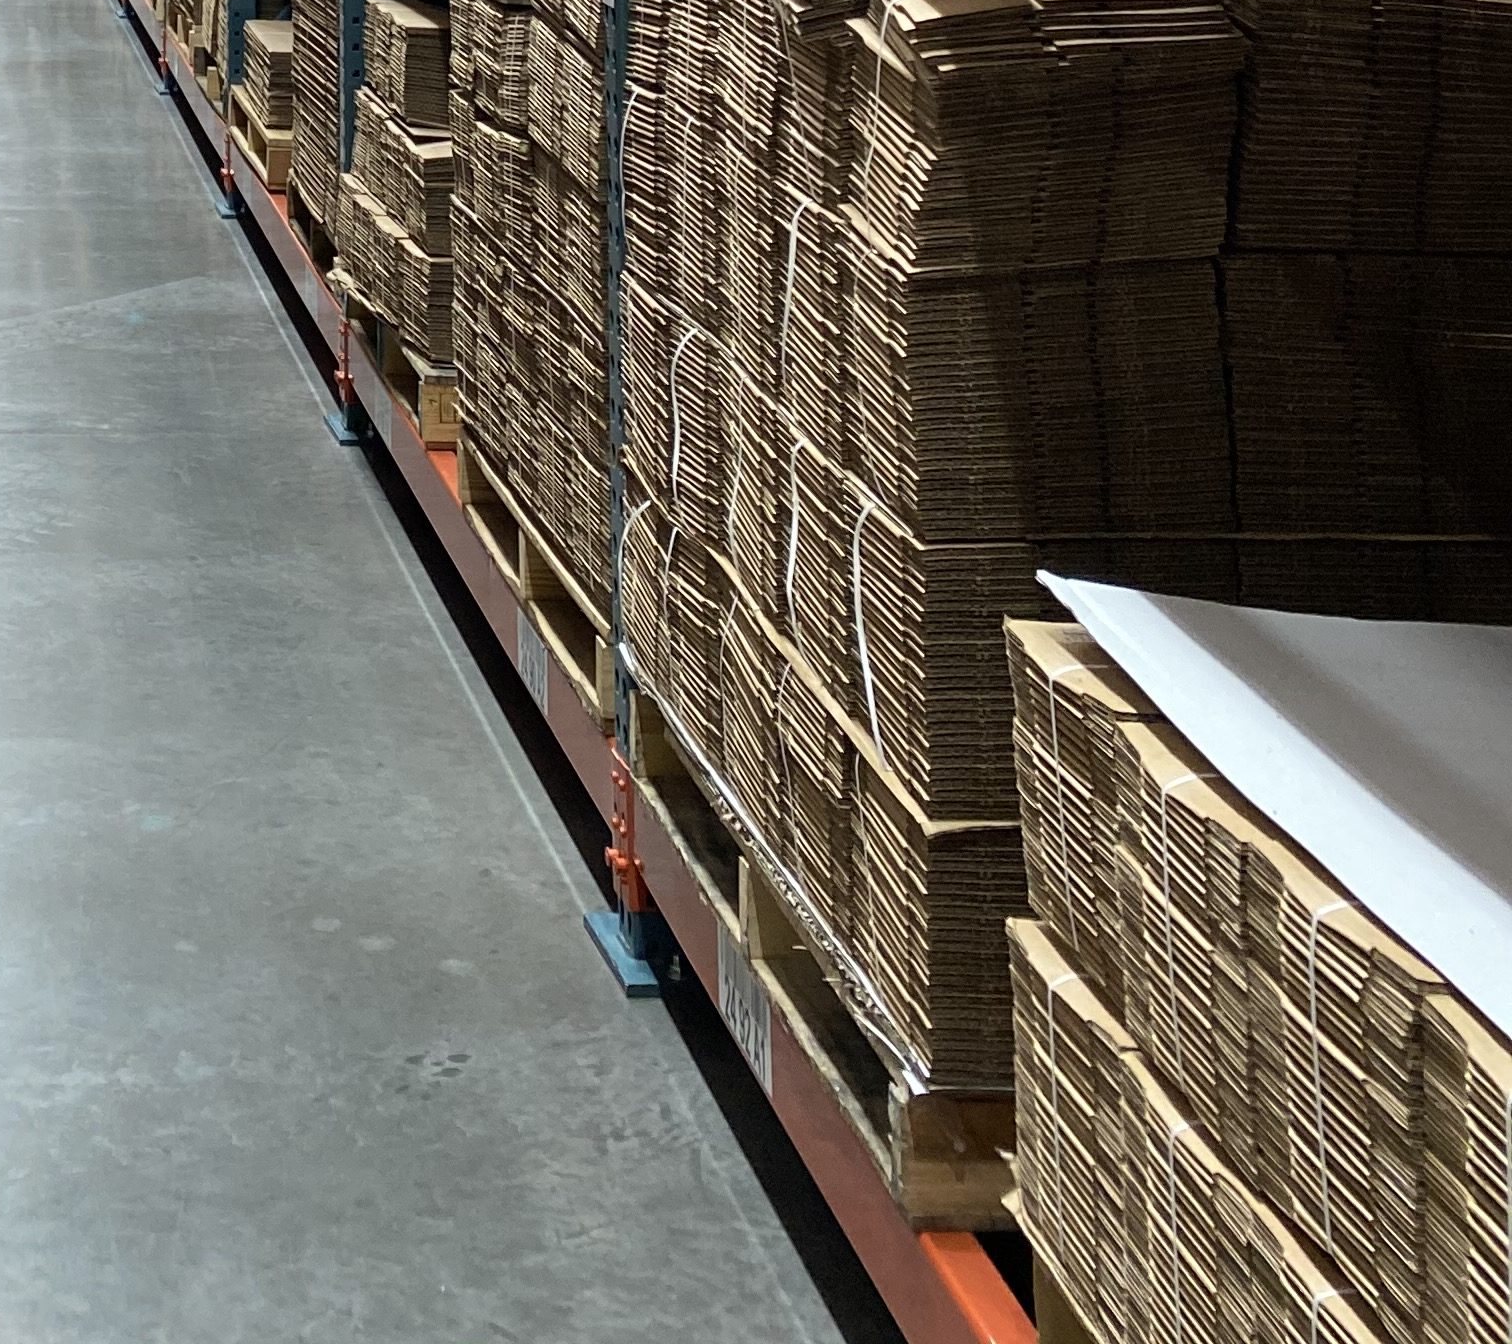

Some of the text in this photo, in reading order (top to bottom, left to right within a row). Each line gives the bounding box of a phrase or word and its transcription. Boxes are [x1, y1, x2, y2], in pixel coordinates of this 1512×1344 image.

[725, 974, 766, 1084] 24 92 A1
